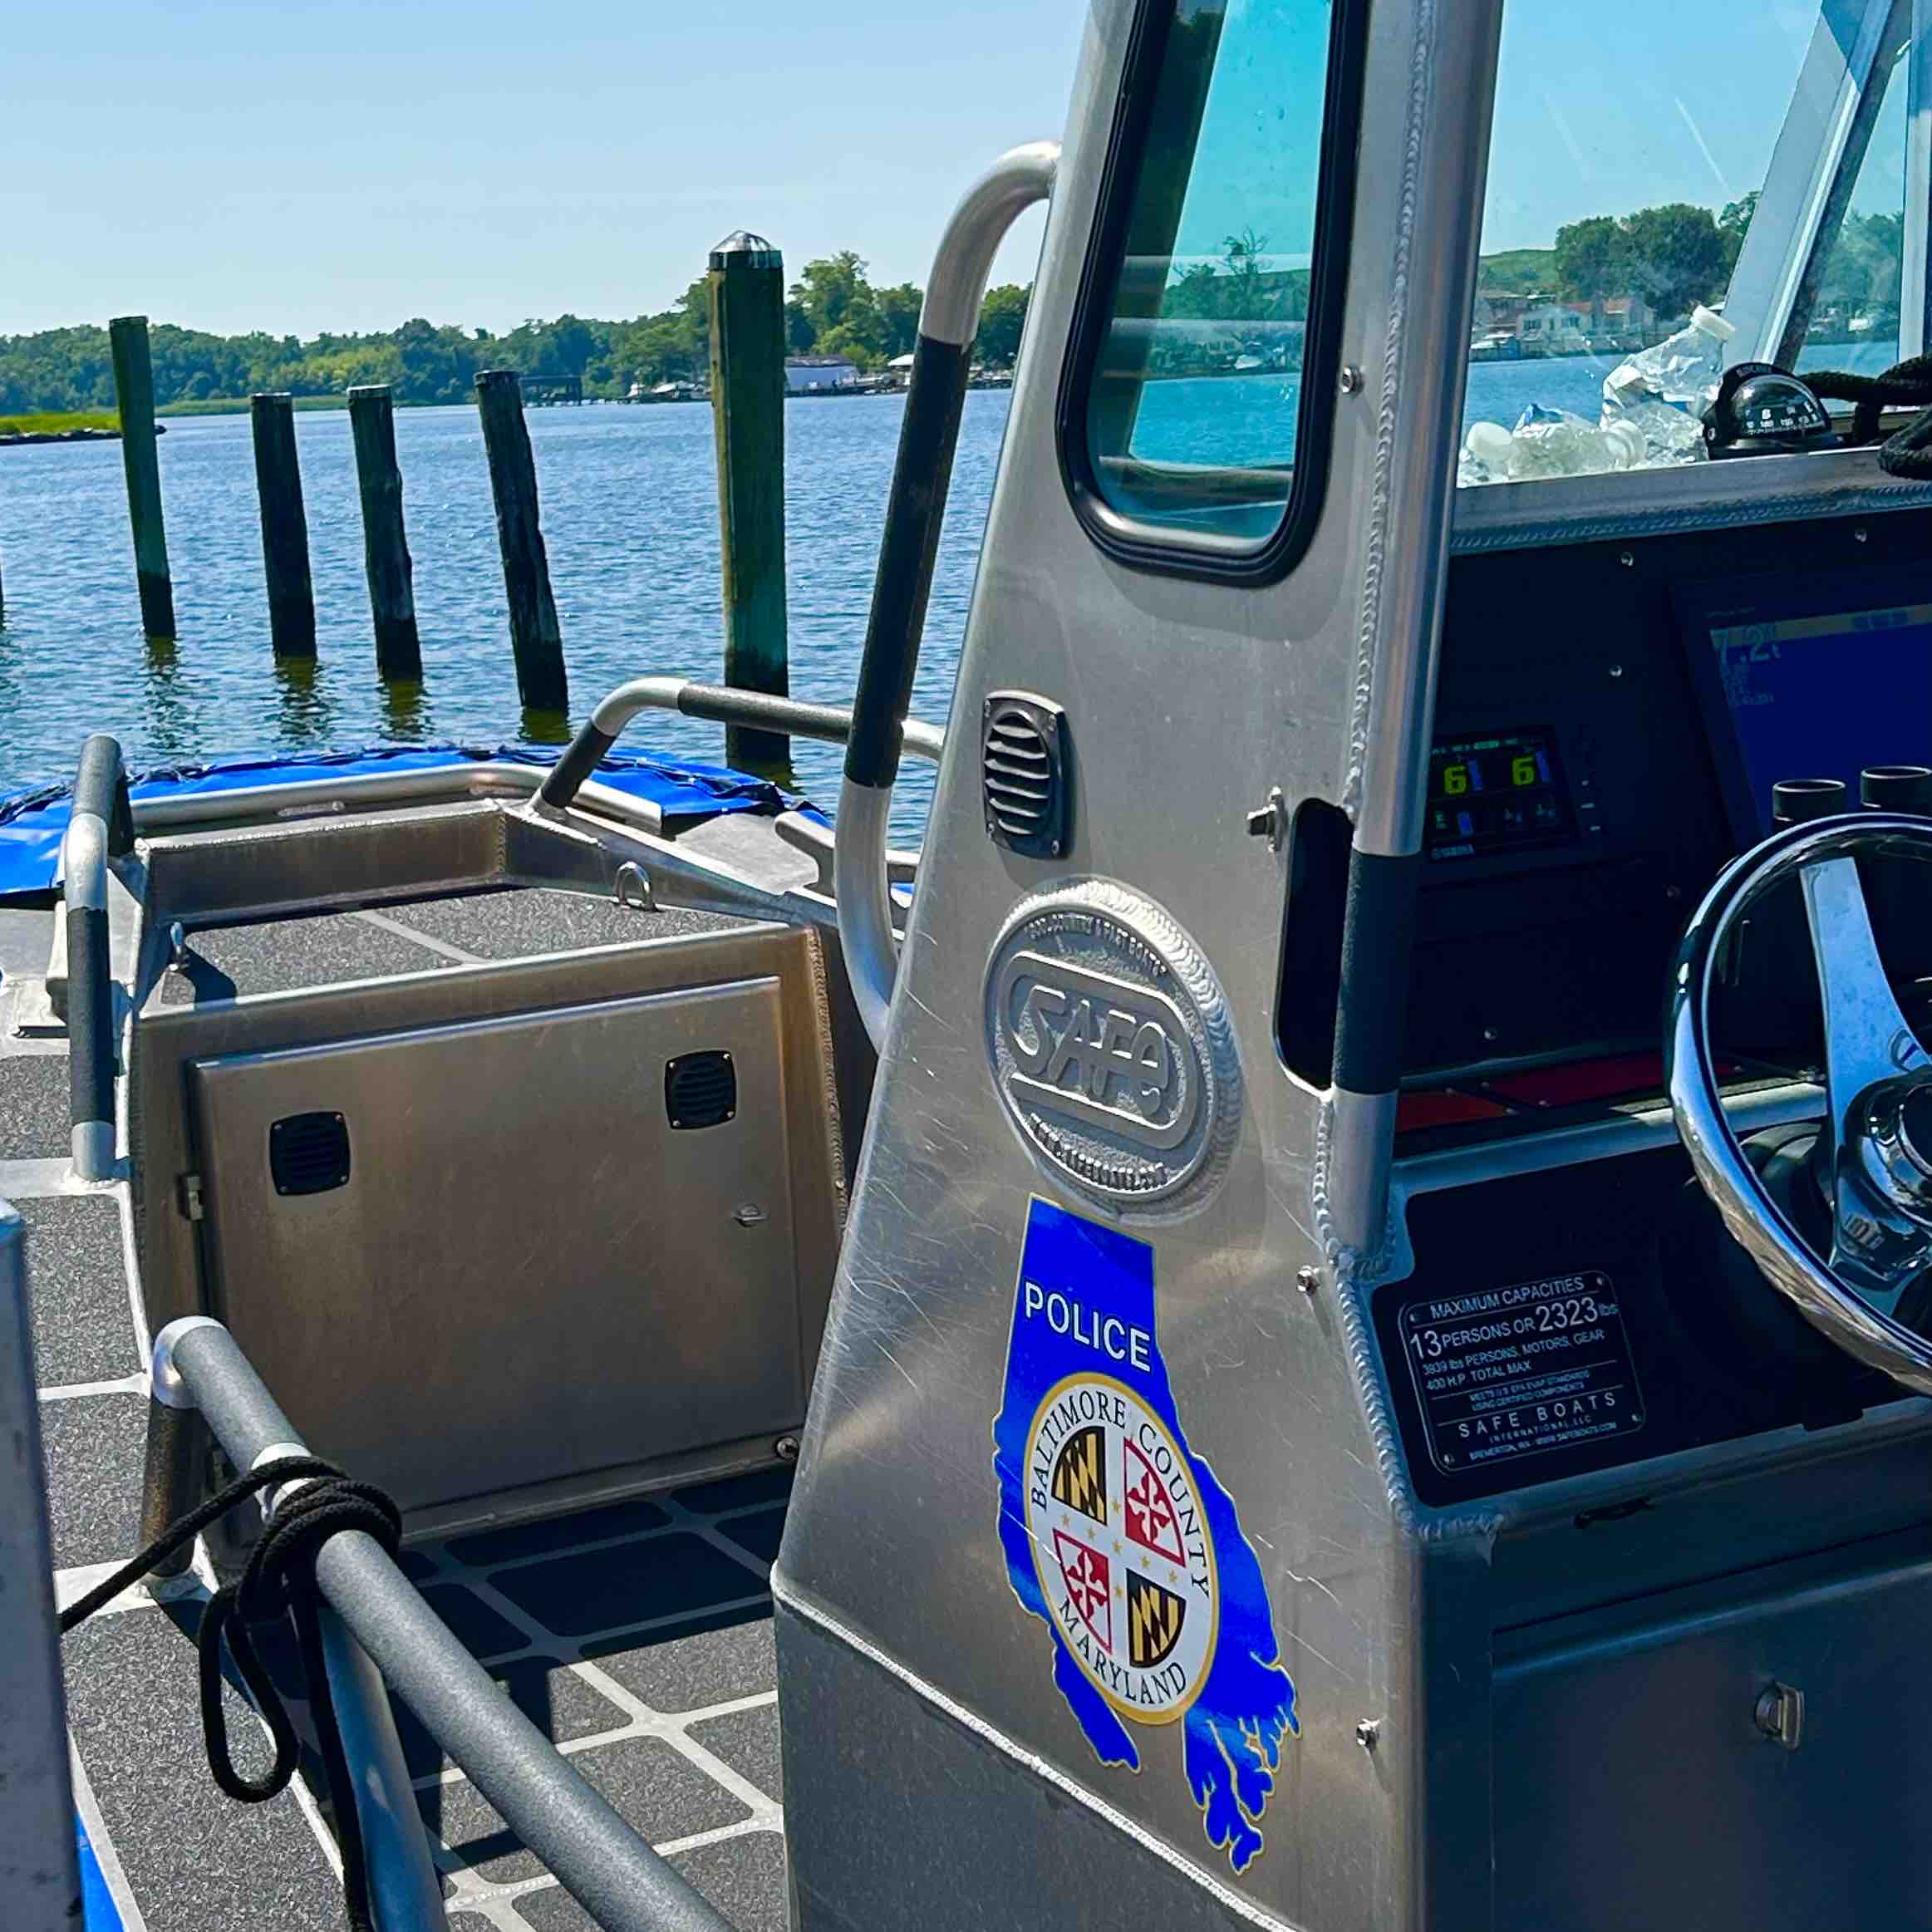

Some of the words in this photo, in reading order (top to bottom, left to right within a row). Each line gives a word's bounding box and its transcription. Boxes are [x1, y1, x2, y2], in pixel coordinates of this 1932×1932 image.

[1430, 1293, 1501, 1320] MAXIMUM
[1502, 1276, 1585, 1305] CAPACITIES
[1025, 1281, 1151, 1372] POLICE
[1410, 1330, 1442, 1359] 13
[1442, 1322, 1512, 1348] PERSONS
[1514, 1317, 1536, 1334] OR
[1536, 1296, 1598, 1331] 2323
[1573, 1329, 1605, 1345] GEAR
[1470, 1365, 1506, 1382] TOTAL
[1458, 1412, 1521, 1438] SAFE
[1536, 1392, 1615, 1422] BOATS
[1031, 1390, 1127, 1512] BALTIMORE
[1138, 1423, 1210, 1599] COUNTY
[1059, 1595, 1187, 1705] MARYLAND
